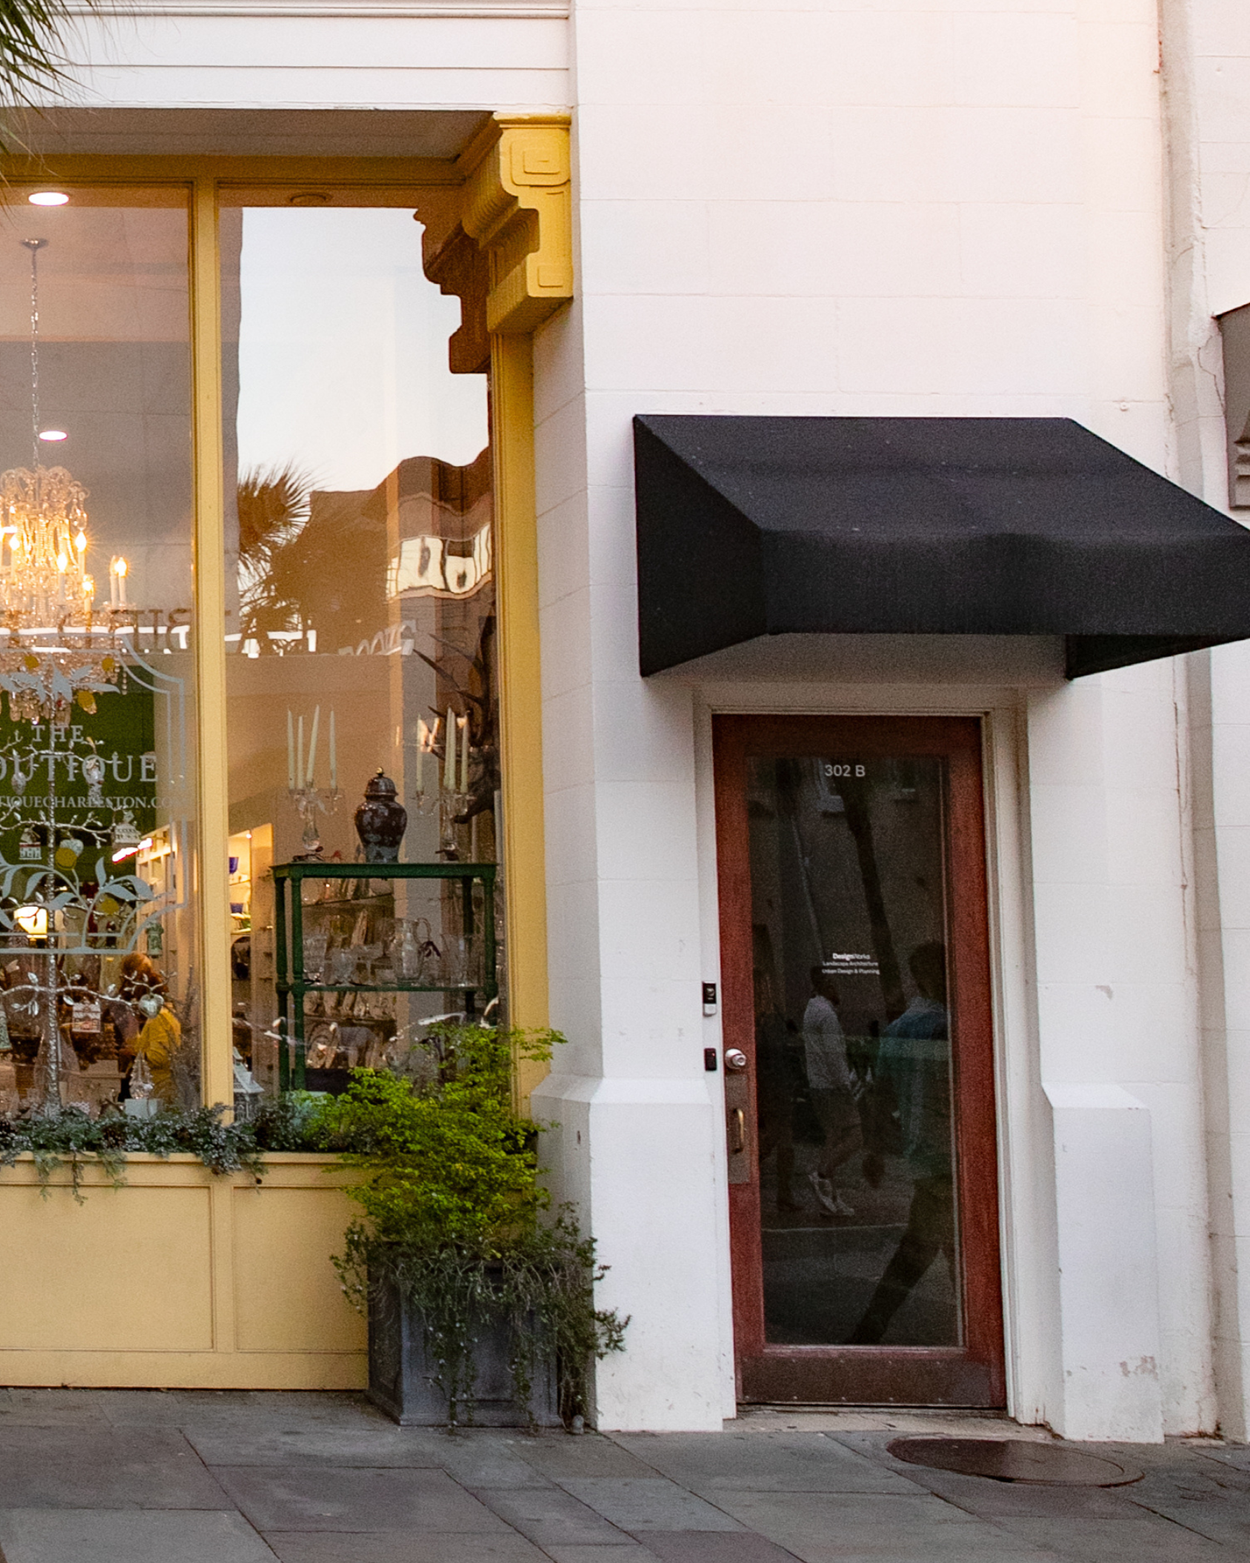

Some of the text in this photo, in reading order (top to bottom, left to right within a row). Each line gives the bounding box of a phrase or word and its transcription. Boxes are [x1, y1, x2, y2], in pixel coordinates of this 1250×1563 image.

[30, 725, 84, 742] THE
[824, 764, 866, 777] 302 B
